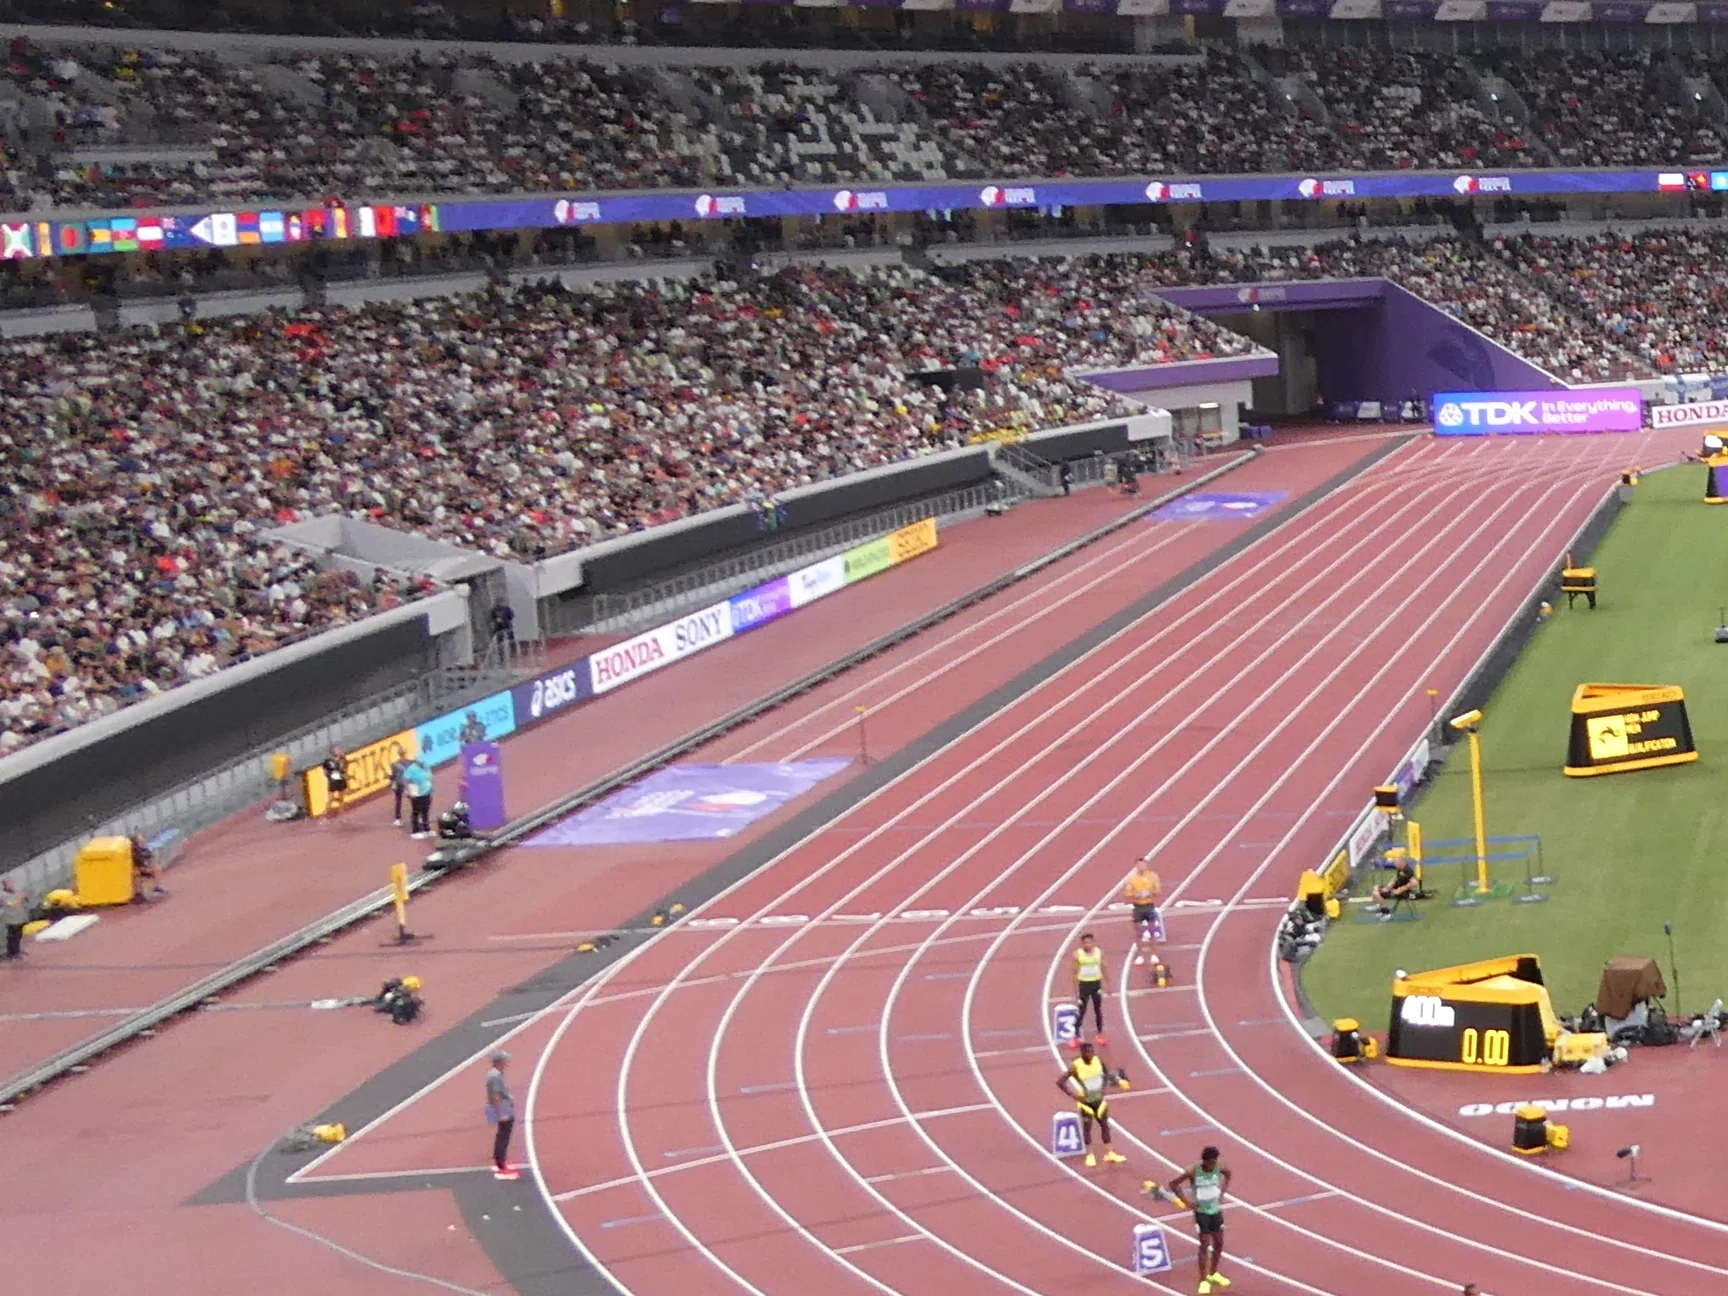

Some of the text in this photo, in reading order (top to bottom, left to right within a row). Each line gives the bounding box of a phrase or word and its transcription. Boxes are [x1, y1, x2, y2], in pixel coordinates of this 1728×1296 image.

[1461, 400, 1539, 425] TDK
[595, 608, 722, 685] HONDA SONY
[544, 668, 577, 709] asics
[1058, 1015, 1076, 1039] 3
[1462, 1027, 1510, 1066] 0.00
[1458, 1094, 1654, 1116] MONDO
[1058, 1125, 1080, 1150] 4
[1141, 1237, 1163, 1267] 5
